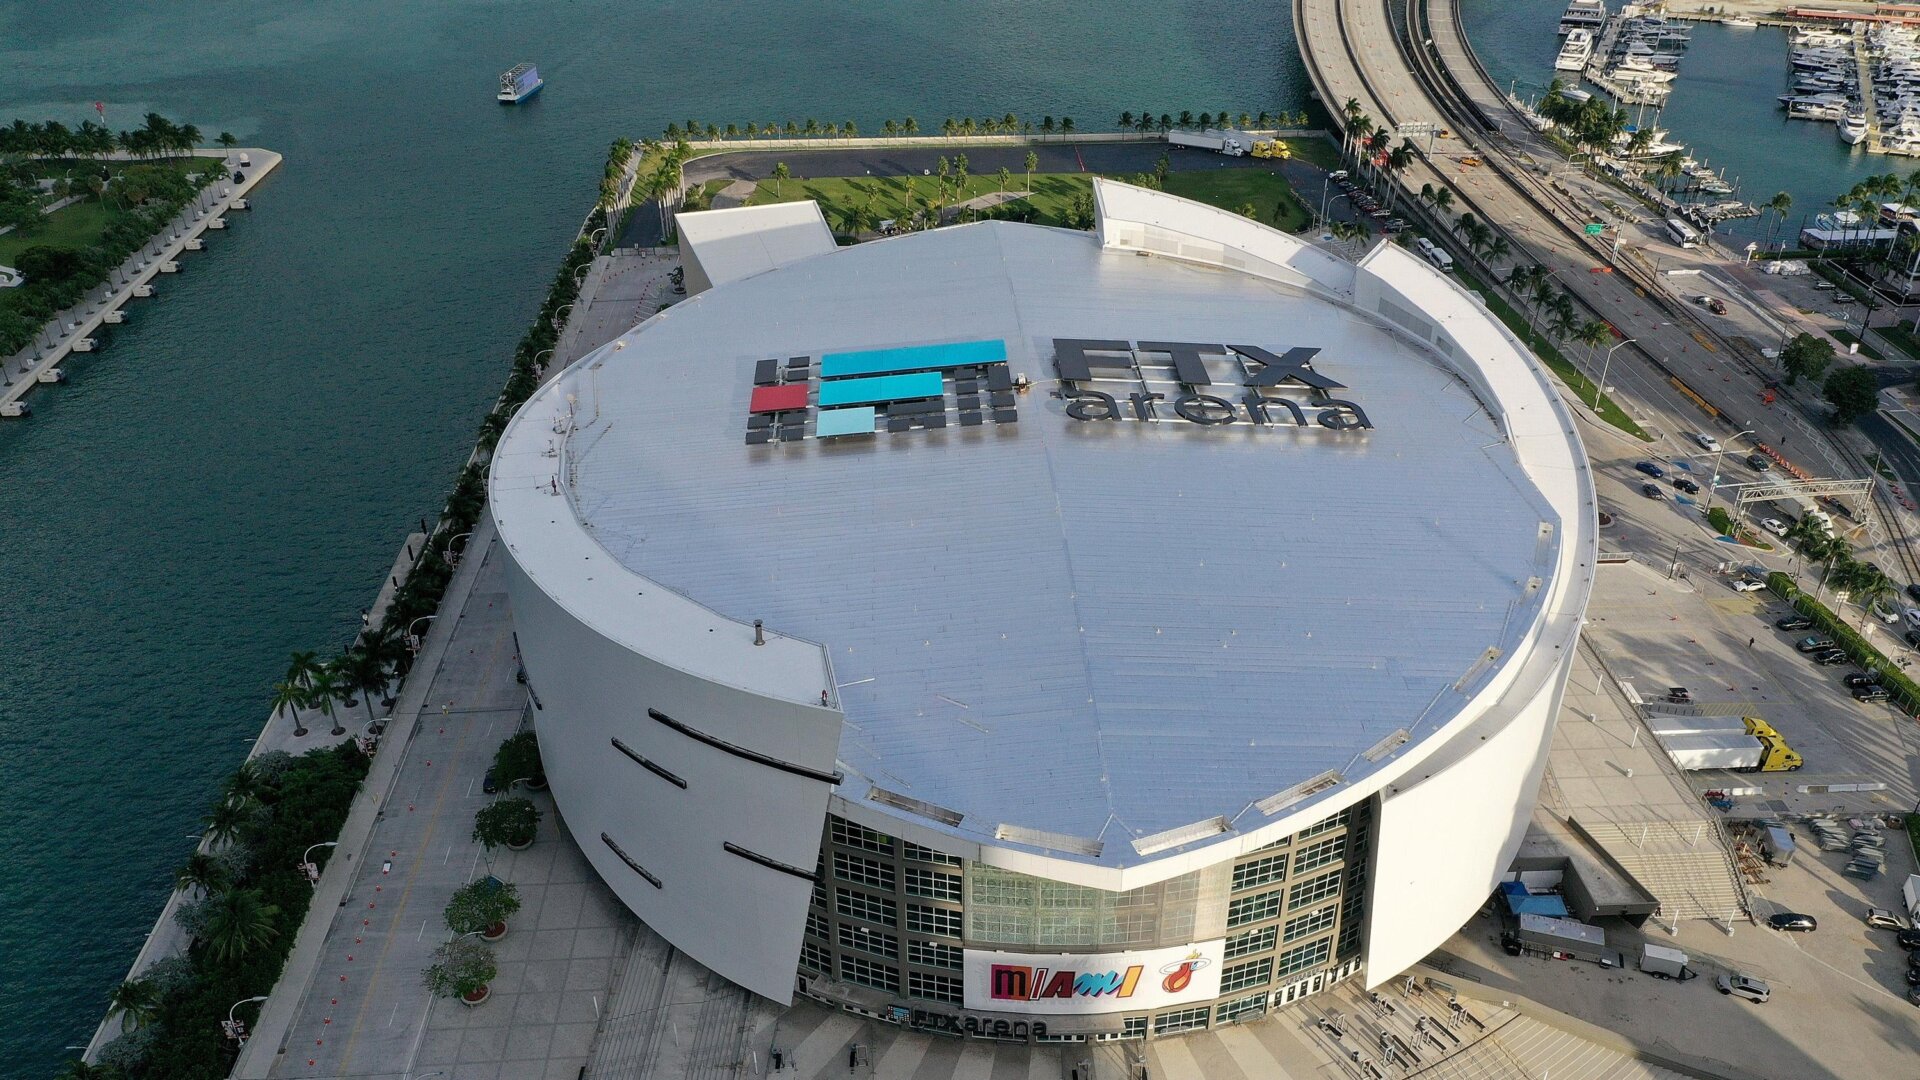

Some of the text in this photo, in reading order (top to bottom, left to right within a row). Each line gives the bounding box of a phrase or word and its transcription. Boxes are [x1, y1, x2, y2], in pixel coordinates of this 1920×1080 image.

[1053, 338, 1349, 389] FTX
[1061, 391, 1375, 430] arena
[914, 1009, 1047, 1036] FTX arena
